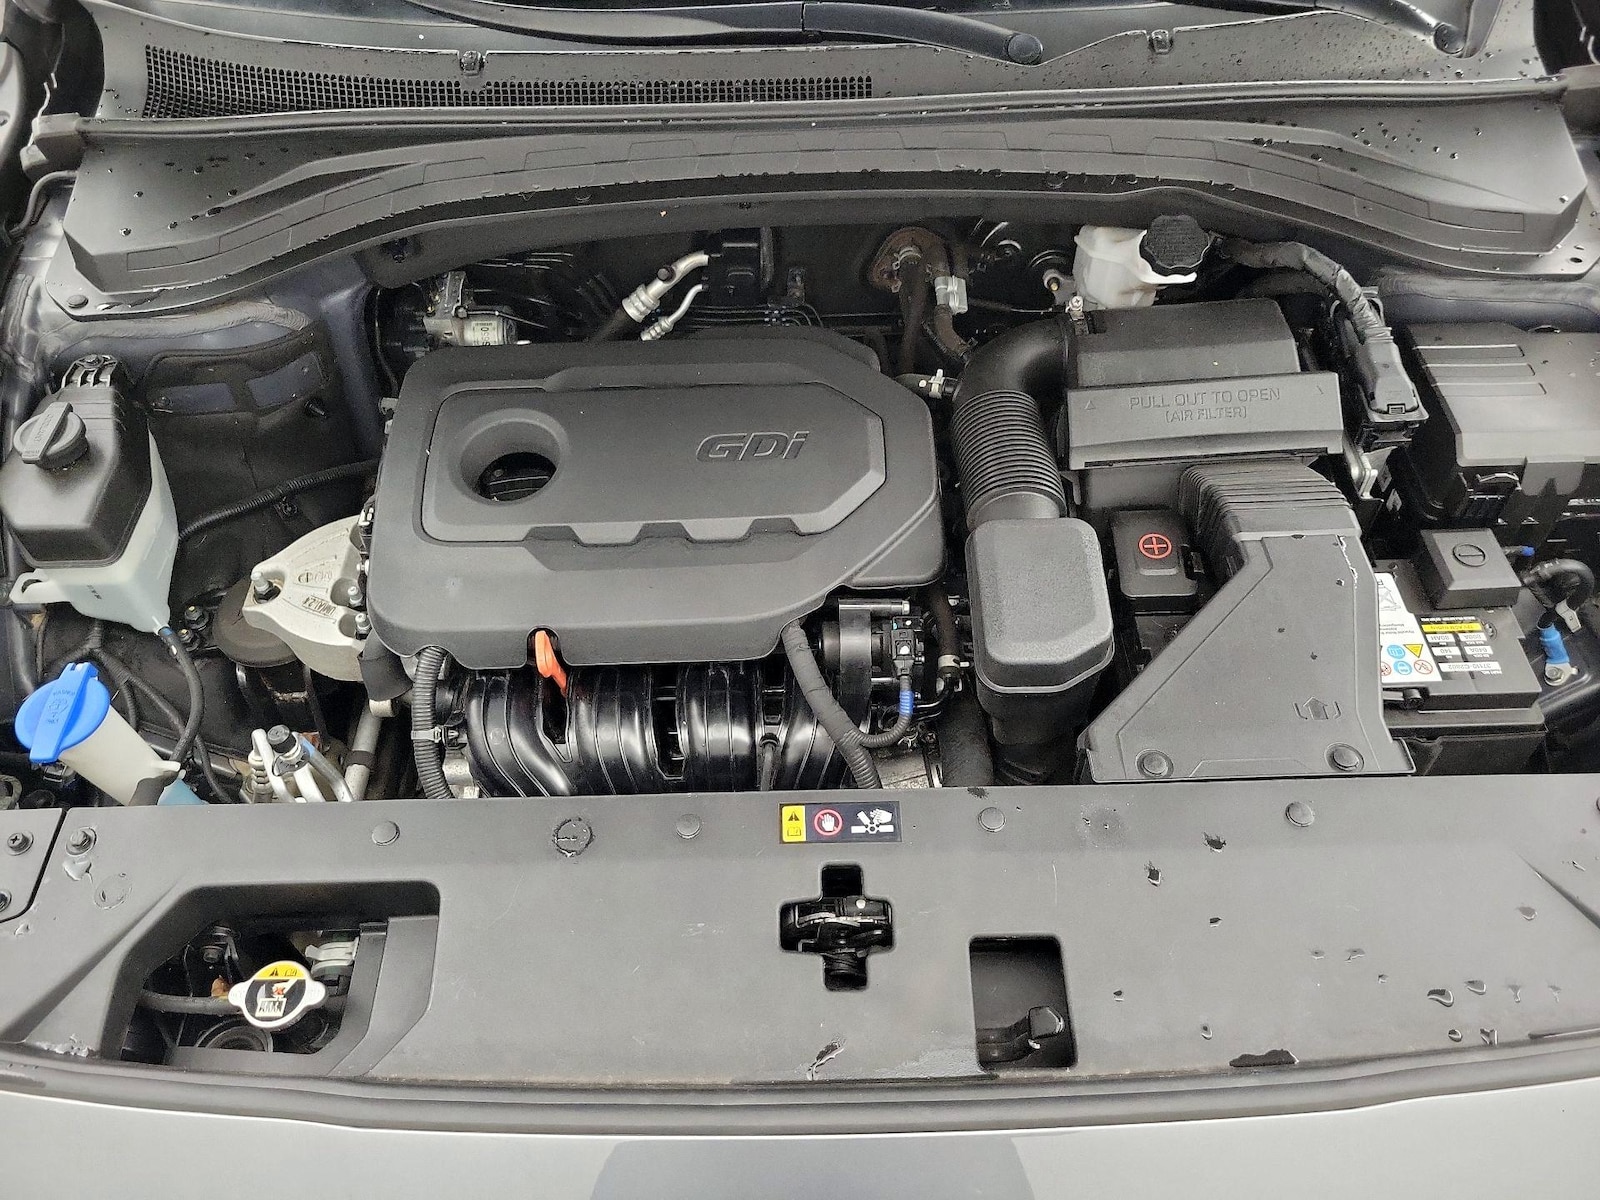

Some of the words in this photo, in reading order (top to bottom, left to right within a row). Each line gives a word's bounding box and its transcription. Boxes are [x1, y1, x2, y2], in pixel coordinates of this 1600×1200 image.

[1129, 394, 1170, 410] PULL
[1175, 392, 1206, 407] OUT
[1211, 390, 1233, 404] TO
[1237, 387, 1281, 403] OPEN
[1165, 408, 1193, 423] (AIR
[1197, 406, 1247, 421] FILTER)
[696, 431, 810, 461] GDi
